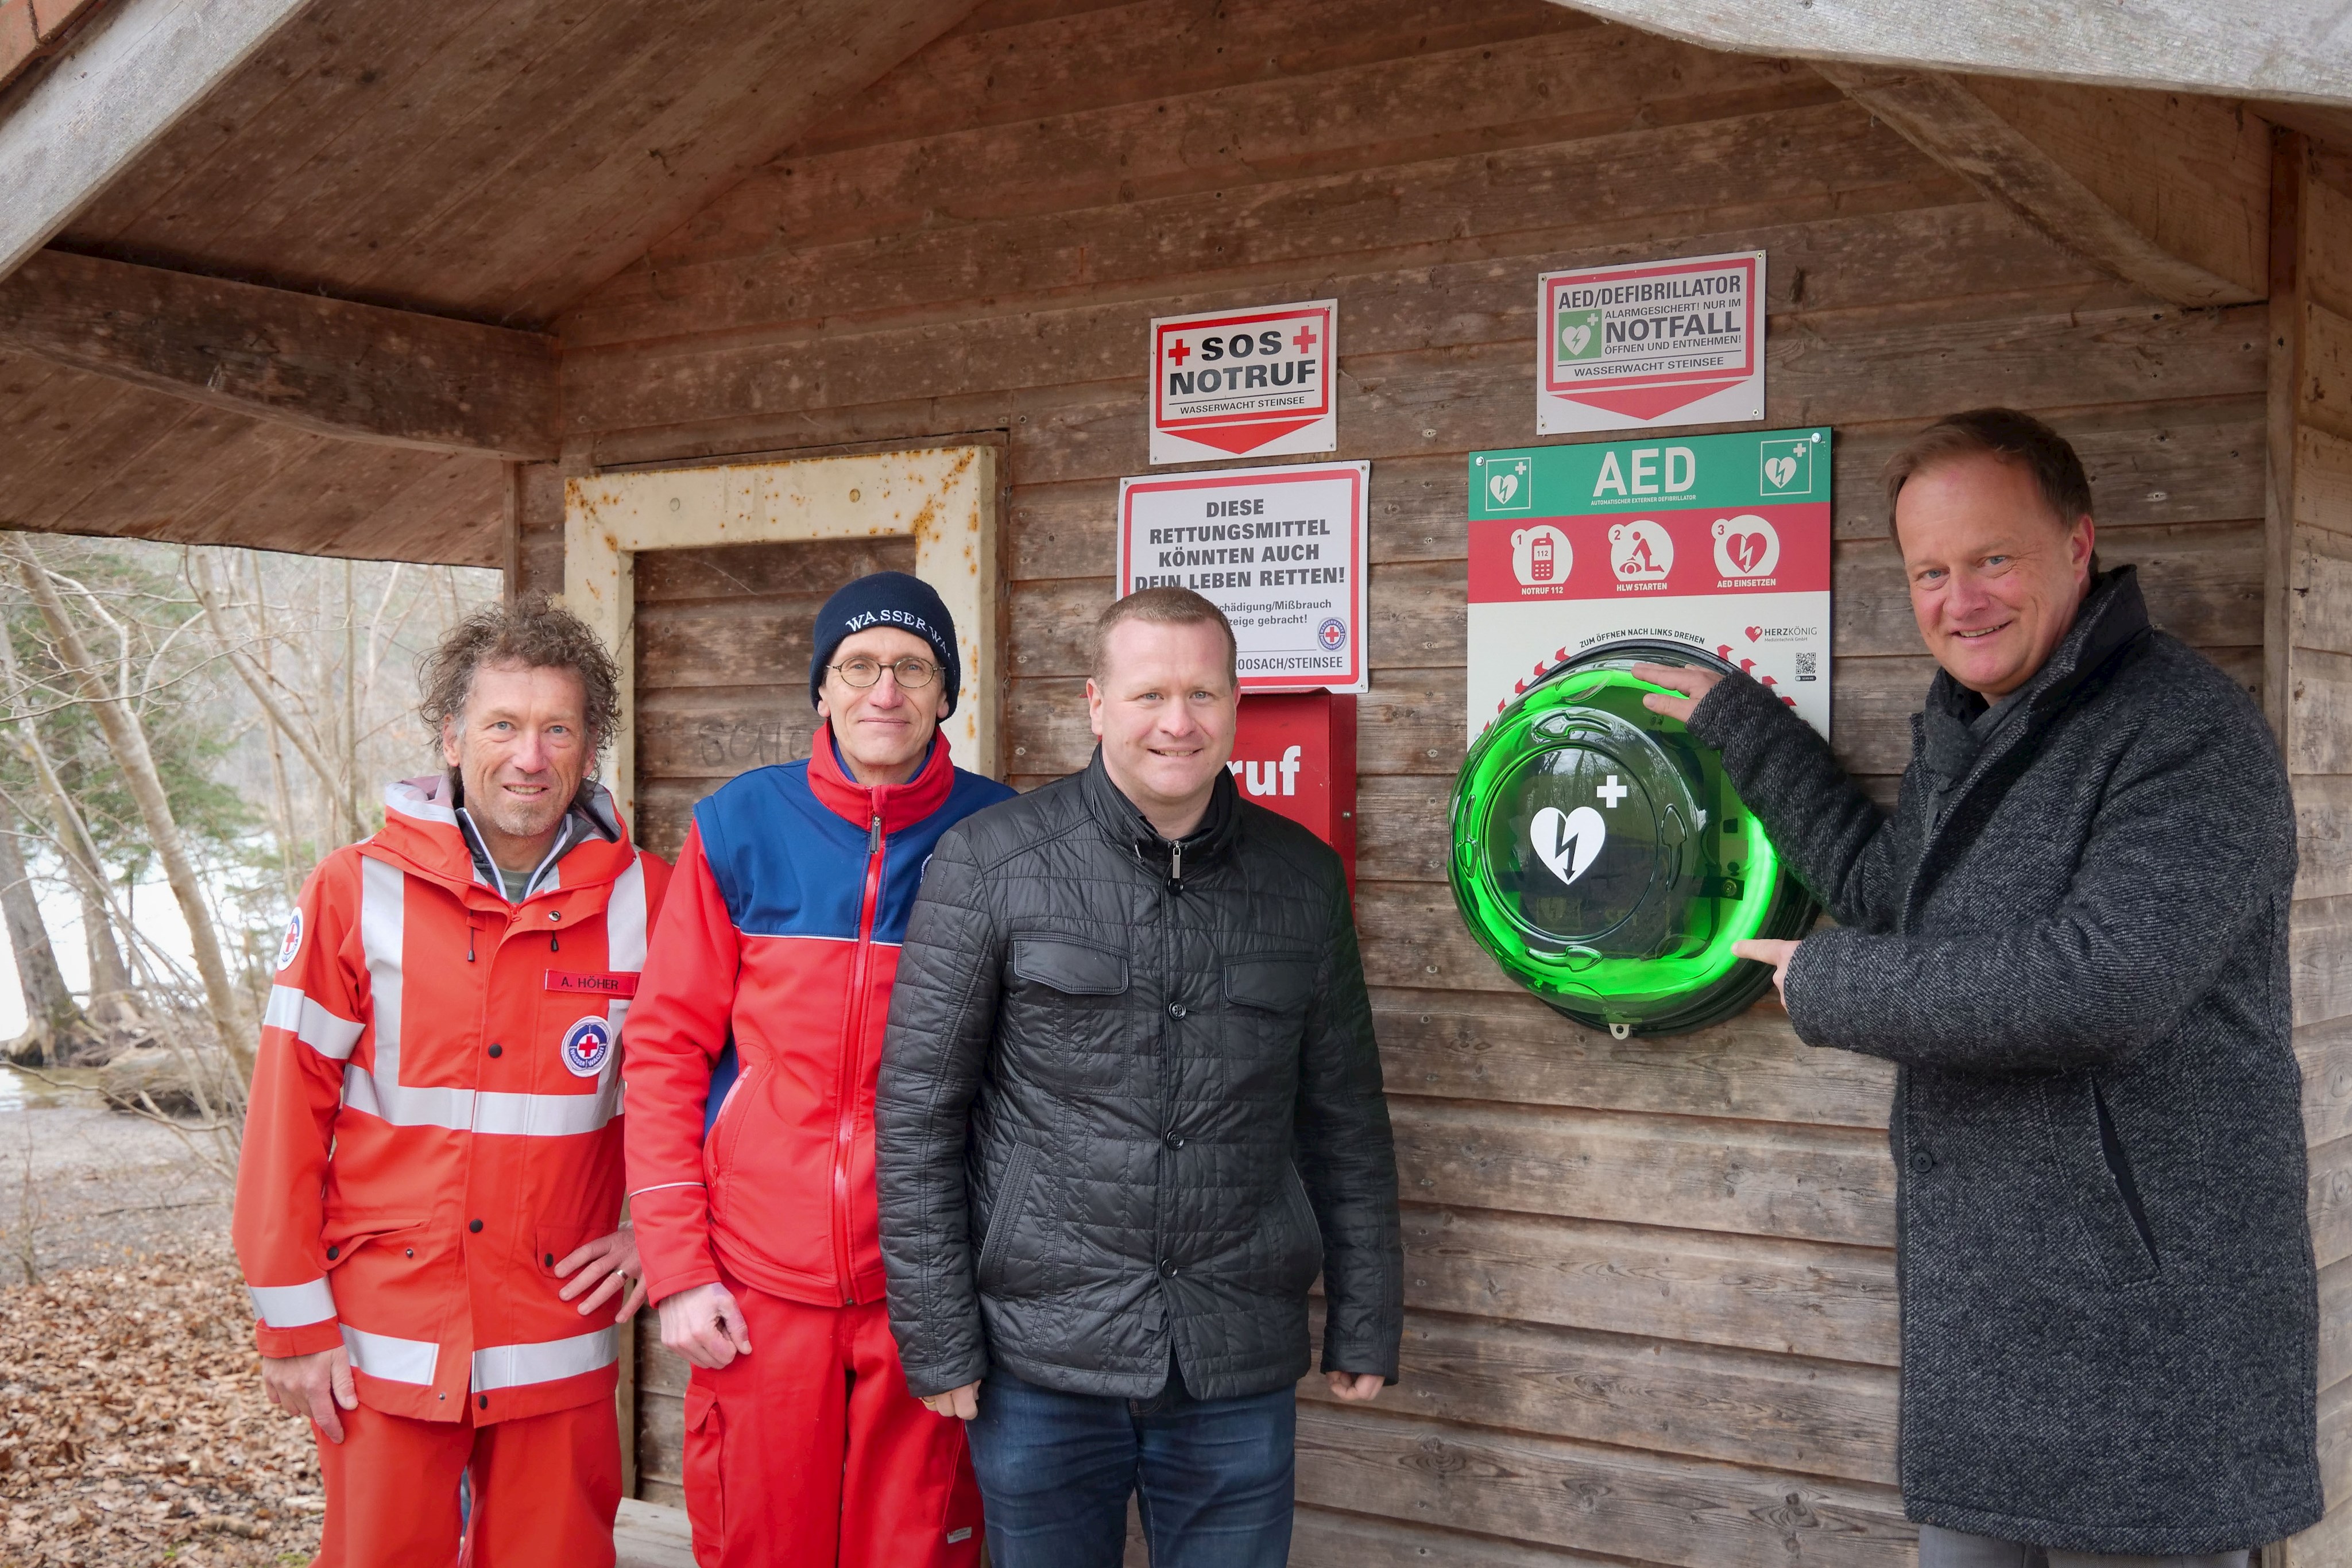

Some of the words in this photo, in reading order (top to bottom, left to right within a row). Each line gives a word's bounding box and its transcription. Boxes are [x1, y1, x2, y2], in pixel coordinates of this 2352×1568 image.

[1558, 276, 1740, 309] AED/DEFIBRILLATOR
[1605, 303, 1700, 319] ALARMGESICHERT!
[1703, 300, 1726, 309] NUR
[1728, 298, 1741, 307] IM
[1606, 311, 1740, 343] NOTFALL
[1201, 331, 1282, 361] SOS
[1605, 343, 1644, 354] ÖFFNEN
[1647, 341, 1669, 351] UND
[1673, 335, 1741, 349] ENTNEHMEN!
[1575, 362, 1664, 377] WASSERWACHT
[1668, 357, 1724, 369] STEINSEE
[1170, 359, 1316, 396] NOTRUF
[1180, 401, 1255, 414] WASSERWACHT
[1258, 396, 1305, 408] STEINSEE
[1593, 447, 1695, 497] AED
[1206, 499, 1264, 517] DIESE
[1591, 498, 1631, 506] AUTOMATISCHER
[1658, 494, 1696, 502] DEFIBRILLATOR
[1150, 519, 1330, 544] RETTUNGSMITTEL
[1614, 529, 1620, 540] 2
[1717, 524, 1724, 535] 3
[1517, 535, 1522, 545] 1
[1159, 547, 1254, 567] KÖNNTEN
[1261, 544, 1319, 562] AUCH
[1135, 575, 1181, 591] DEIN
[1189, 571, 1251, 589] LEBEN
[1260, 567, 1344, 586] RETTEN!
[1616, 584, 1633, 592] HLW
[1634, 582, 1668, 591] STARTEN
[1717, 580, 1732, 588] AED
[1734, 578, 1776, 587] EINSETZEN
[1522, 587, 1549, 595] NOTRUF
[1551, 586, 1563, 594] 112
[1218, 599, 1331, 614] chädigung/Mißbrauch
[1228, 617, 1254, 628] zeige
[1258, 614, 1307, 626] gebracht!
[1579, 637, 1595, 648] ZUM
[1596, 630, 1626, 641] ÖFFNEN
[1674, 630, 1705, 644] DREHEN
[1765, 626, 1817, 636] HERZKÖNIG
[1237, 657, 1343, 671] OOSACH/STEINSEE
[1226, 745, 1301, 796] ruf
[560, 976, 572, 987] A.
[578, 975, 618, 990] HÖHER
[587, 1047, 605, 1067] WACHT
